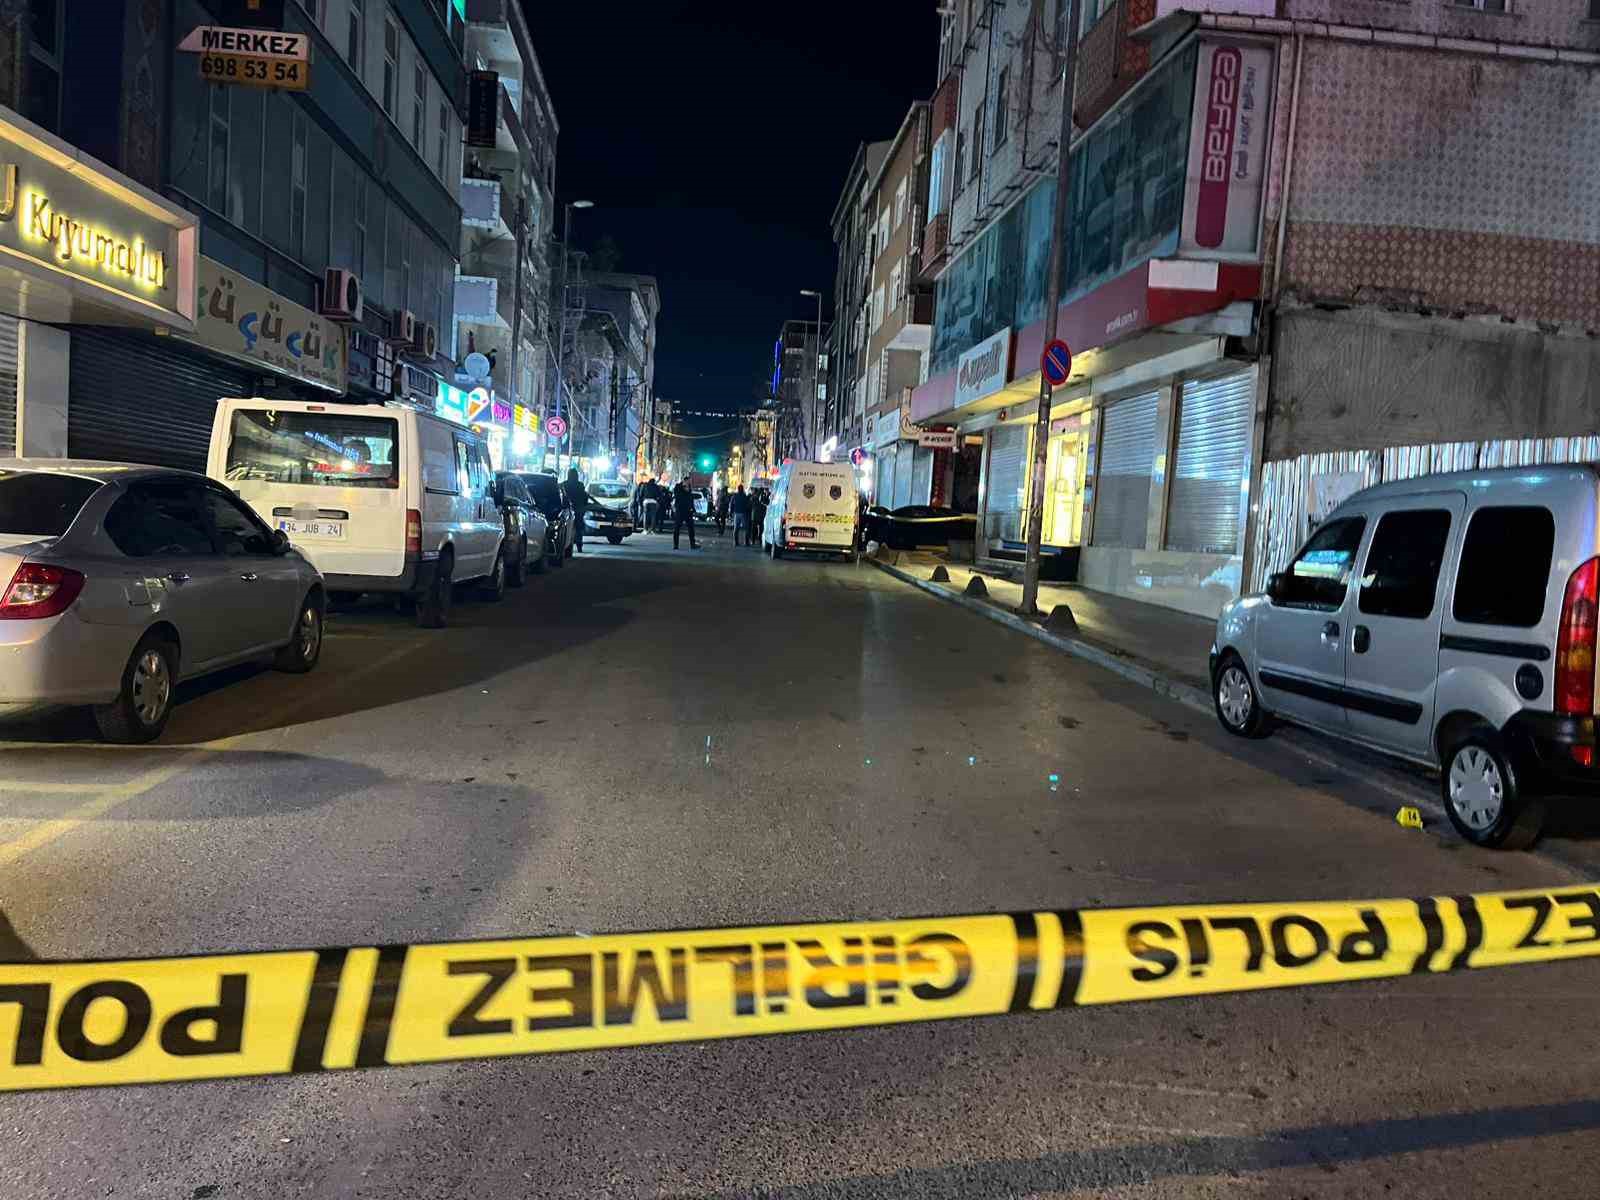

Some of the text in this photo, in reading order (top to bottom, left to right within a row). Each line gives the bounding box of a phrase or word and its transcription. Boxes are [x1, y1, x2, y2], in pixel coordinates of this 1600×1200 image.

[202, 30, 298, 55] MERKEZ
[201, 57, 299, 82] 698 53 54
[286, 523, 297, 534] 34
[1126, 909, 1388, 981] POLİS
[447, 933, 972, 1036] GİRİLMEZ
